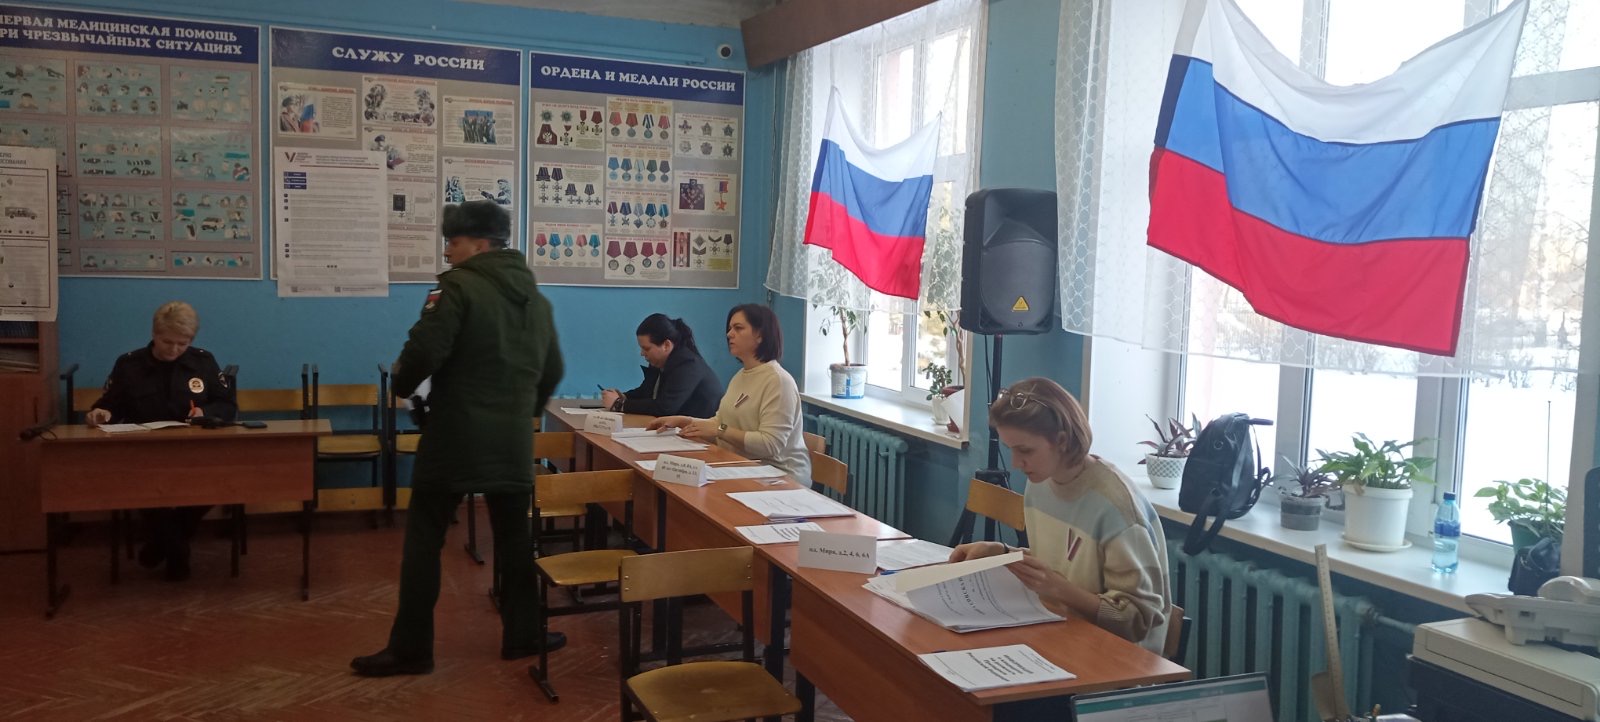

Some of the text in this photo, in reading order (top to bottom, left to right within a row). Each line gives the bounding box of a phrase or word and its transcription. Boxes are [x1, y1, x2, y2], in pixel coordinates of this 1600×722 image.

[0, 28, 242, 55] РИ ЧРЕЗВЫЧАЙНЫХ СИТУАЦИЯХ
[57, 17, 170, 36] МЕДИЦИНСКАЯ
[175, 28, 238, 42] ПОМОЩЬ
[332, 46, 485, 71] СЛУЖУ РОССИИ
[541, 65, 736, 92] ОРДЕНА И МЕДАЛИ РОССИИ
